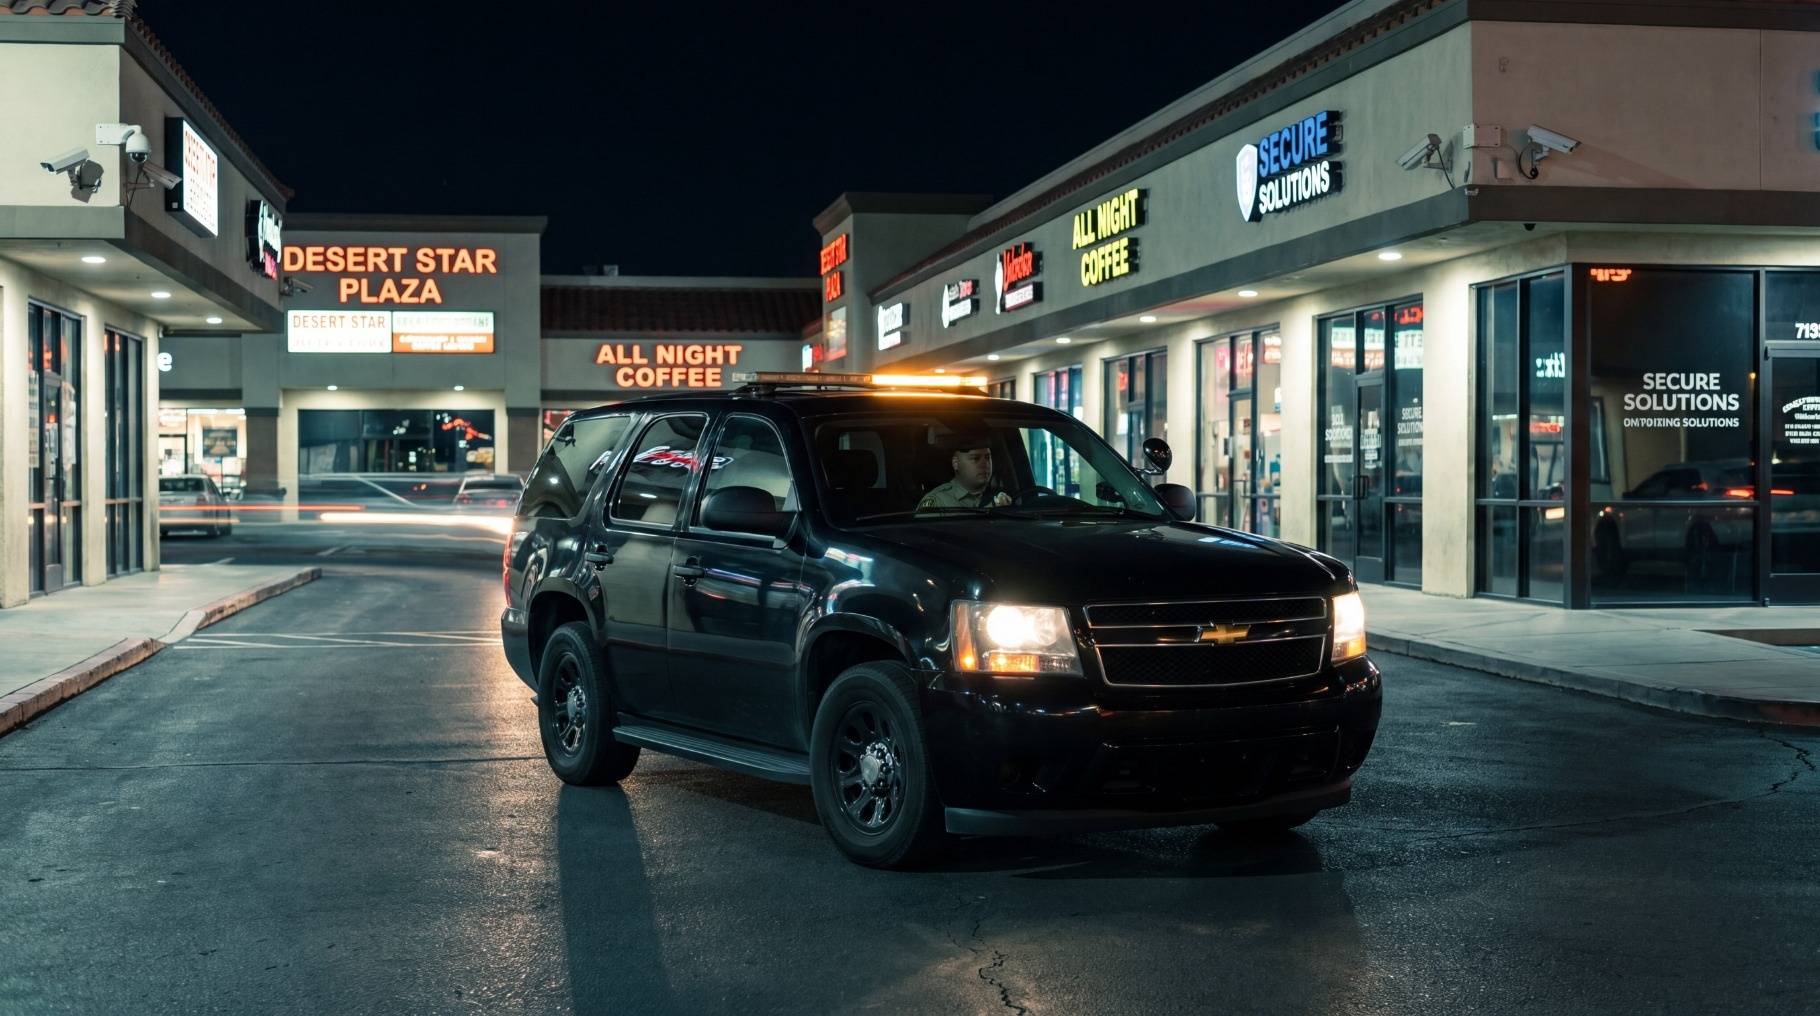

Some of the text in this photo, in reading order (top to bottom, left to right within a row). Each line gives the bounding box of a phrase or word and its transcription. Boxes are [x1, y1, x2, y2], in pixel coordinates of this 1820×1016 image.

[1259, 111, 1327, 177] SECURE
[1259, 161, 1330, 214] SOLUTIONS
[1072, 188, 1139, 250] ALL NIGHT
[283, 246, 407, 272] DESERT
[416, 247, 497, 273] STAR
[1081, 237, 1130, 287] COFFEE
[339, 278, 442, 304] PLAZA
[293, 315, 346, 329] DESERT
[351, 315, 386, 329] STAR
[596, 344, 742, 366] ALL NIGHT
[616, 367, 722, 387] COFFEE
[1643, 373, 1720, 390] SECURE
[1624, 393, 1740, 411] SOLUTIONS
[1682, 418, 1740, 428] SOLUTIONS
